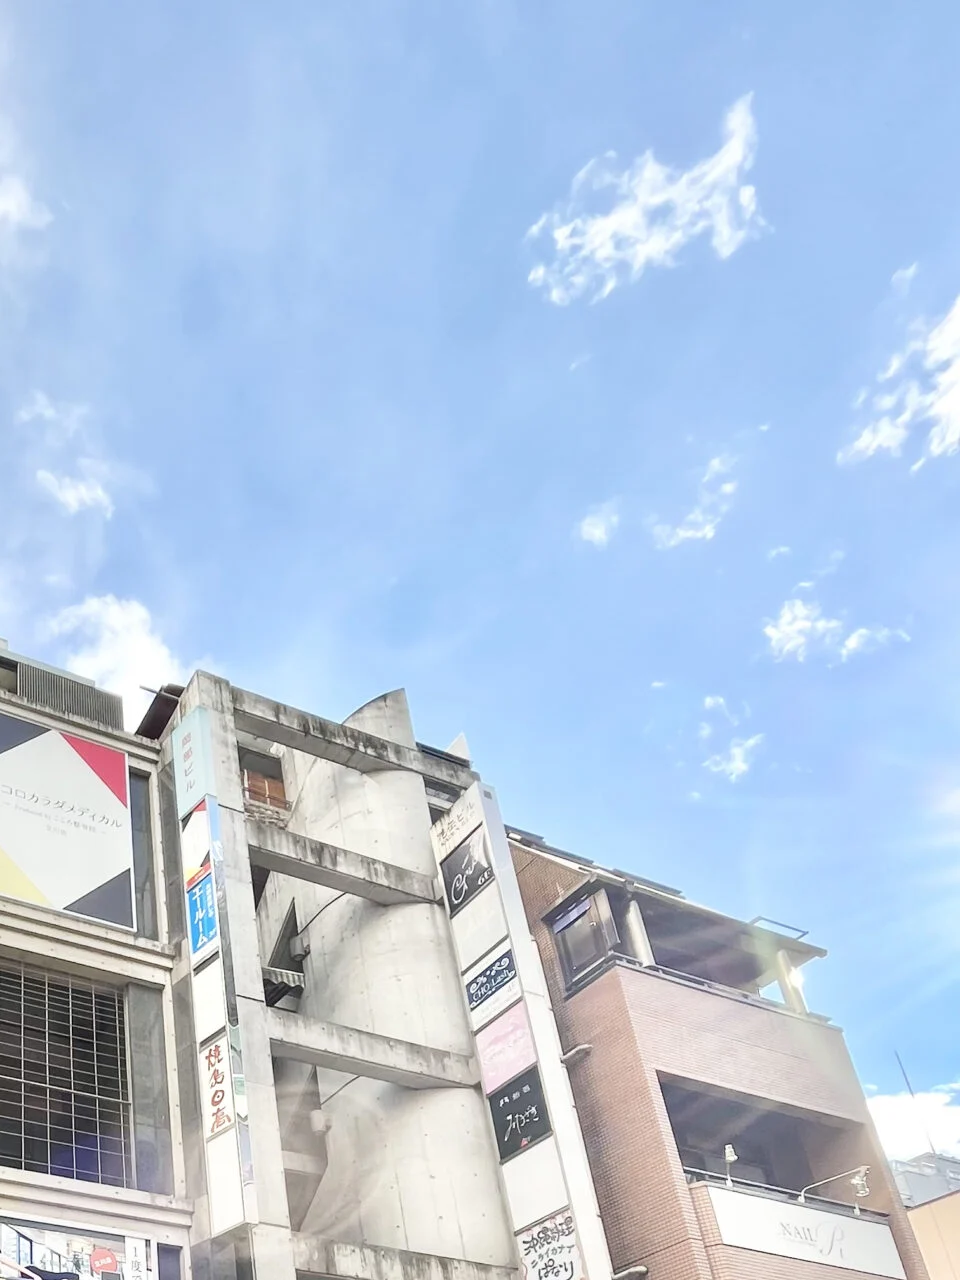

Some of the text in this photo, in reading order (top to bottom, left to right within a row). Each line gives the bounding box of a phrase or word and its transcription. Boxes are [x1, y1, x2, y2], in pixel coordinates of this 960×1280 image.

[192, 885, 208, 949] エールーム
